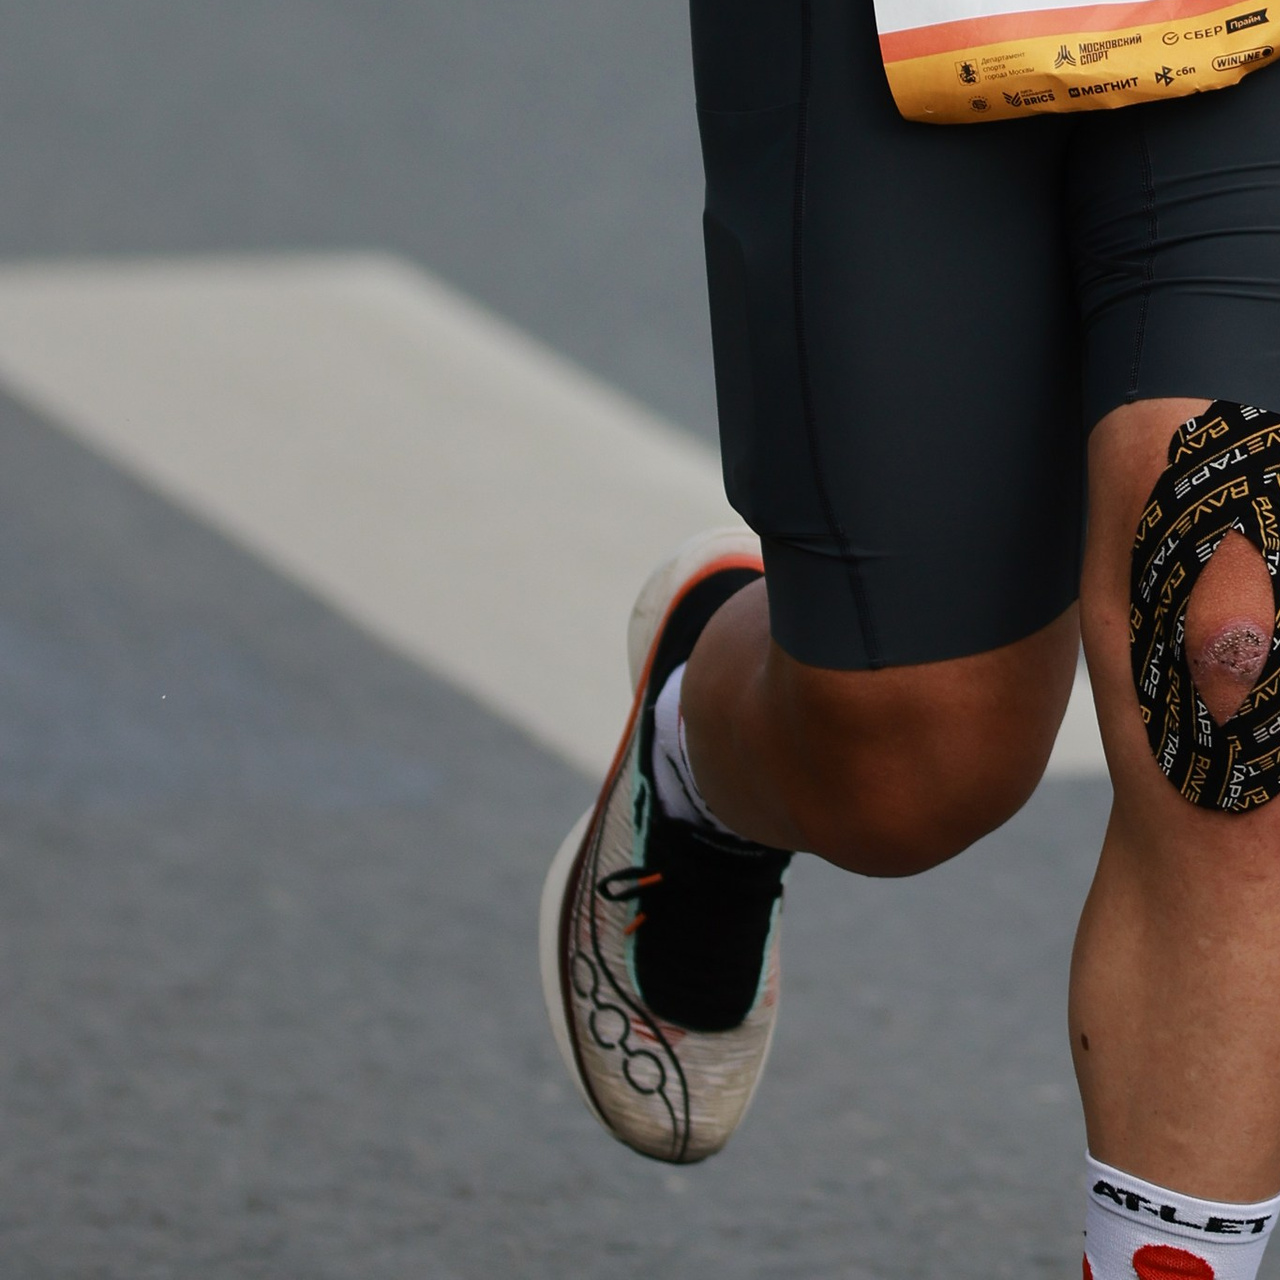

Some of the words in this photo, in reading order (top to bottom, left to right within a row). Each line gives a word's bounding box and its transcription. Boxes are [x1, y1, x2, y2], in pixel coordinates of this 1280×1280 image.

[1183, 25, 1223, 41] СБЕР
[1229, 14, 1262, 30] Прайм
[1079, 33, 1143, 54] МОСКОВСКИЙ
[981, 51, 1026, 65] Департамент
[1080, 50, 1110, 66] СПОРТ
[1216, 51, 1262, 69] WINLINE
[983, 63, 1007, 73] спорта
[1023, 93, 1056, 107] BRICS
